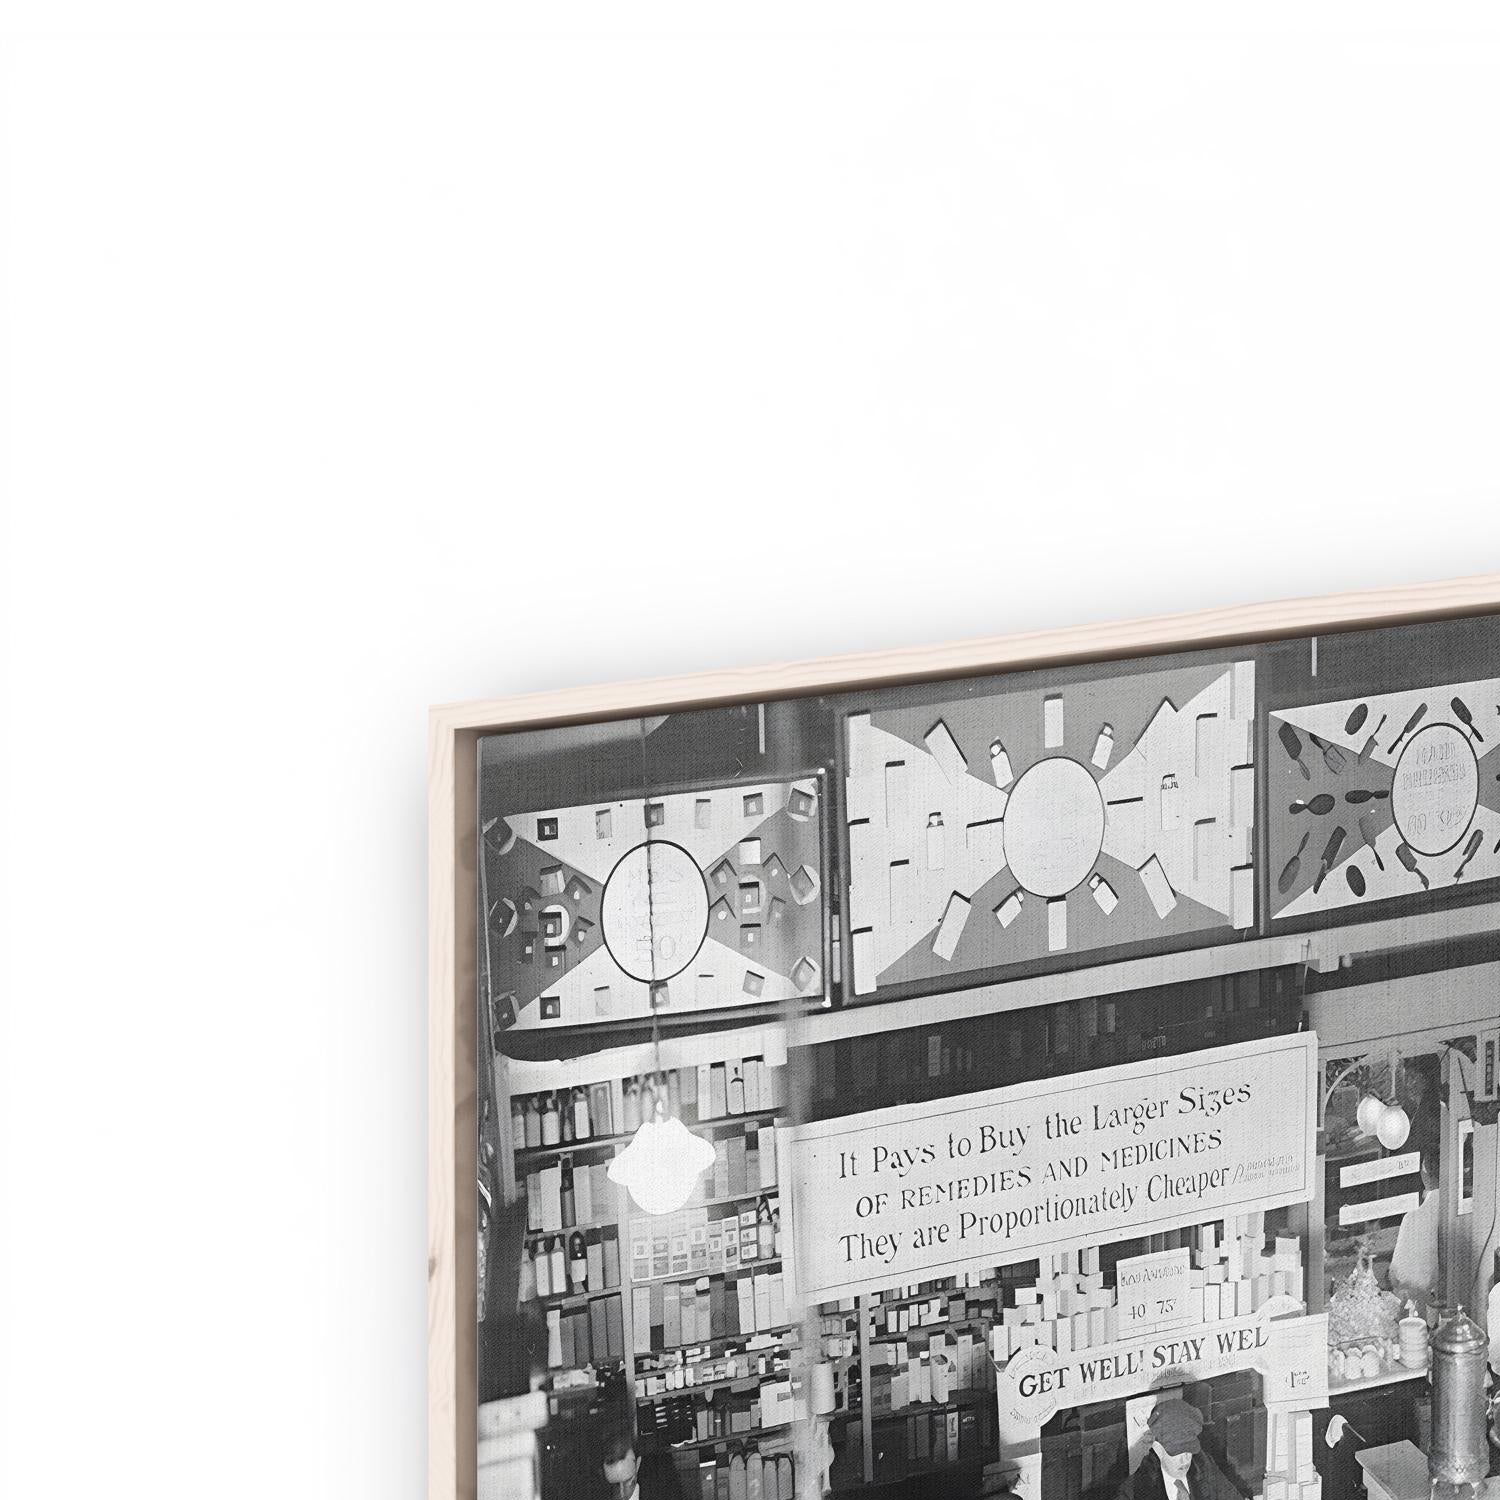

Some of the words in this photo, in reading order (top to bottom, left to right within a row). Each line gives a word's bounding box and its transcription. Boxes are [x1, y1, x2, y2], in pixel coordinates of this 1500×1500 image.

[839, 1151, 859, 1179] It
[872, 1143, 937, 1178] Pays
[947, 1132, 972, 1159] to
[979, 1124, 1031, 1157] Buy
[1045, 1112, 1083, 1140] the
[1093, 1097, 1169, 1136] Larger
[1178, 1083, 1252, 1117] Sizes
[855, 1193, 889, 1218] OF
[901, 1165, 1032, 1210] REMEDIES
[1042, 1156, 1089, 1184] AND
[1100, 1129, 1223, 1172] MEDICINES
[838, 1231, 903, 1264] They
[912, 1222, 950, 1249] are
[959, 1182, 1139, 1240] Proportionately
[1147, 1166, 1231, 1203] Cheaper
[1018, 1367, 1070, 1398] GET
[1079, 1349, 1145, 1384] WELL!
[1151, 1337, 1206, 1370] STAY
[1216, 1326, 1271, 1354] WEL
